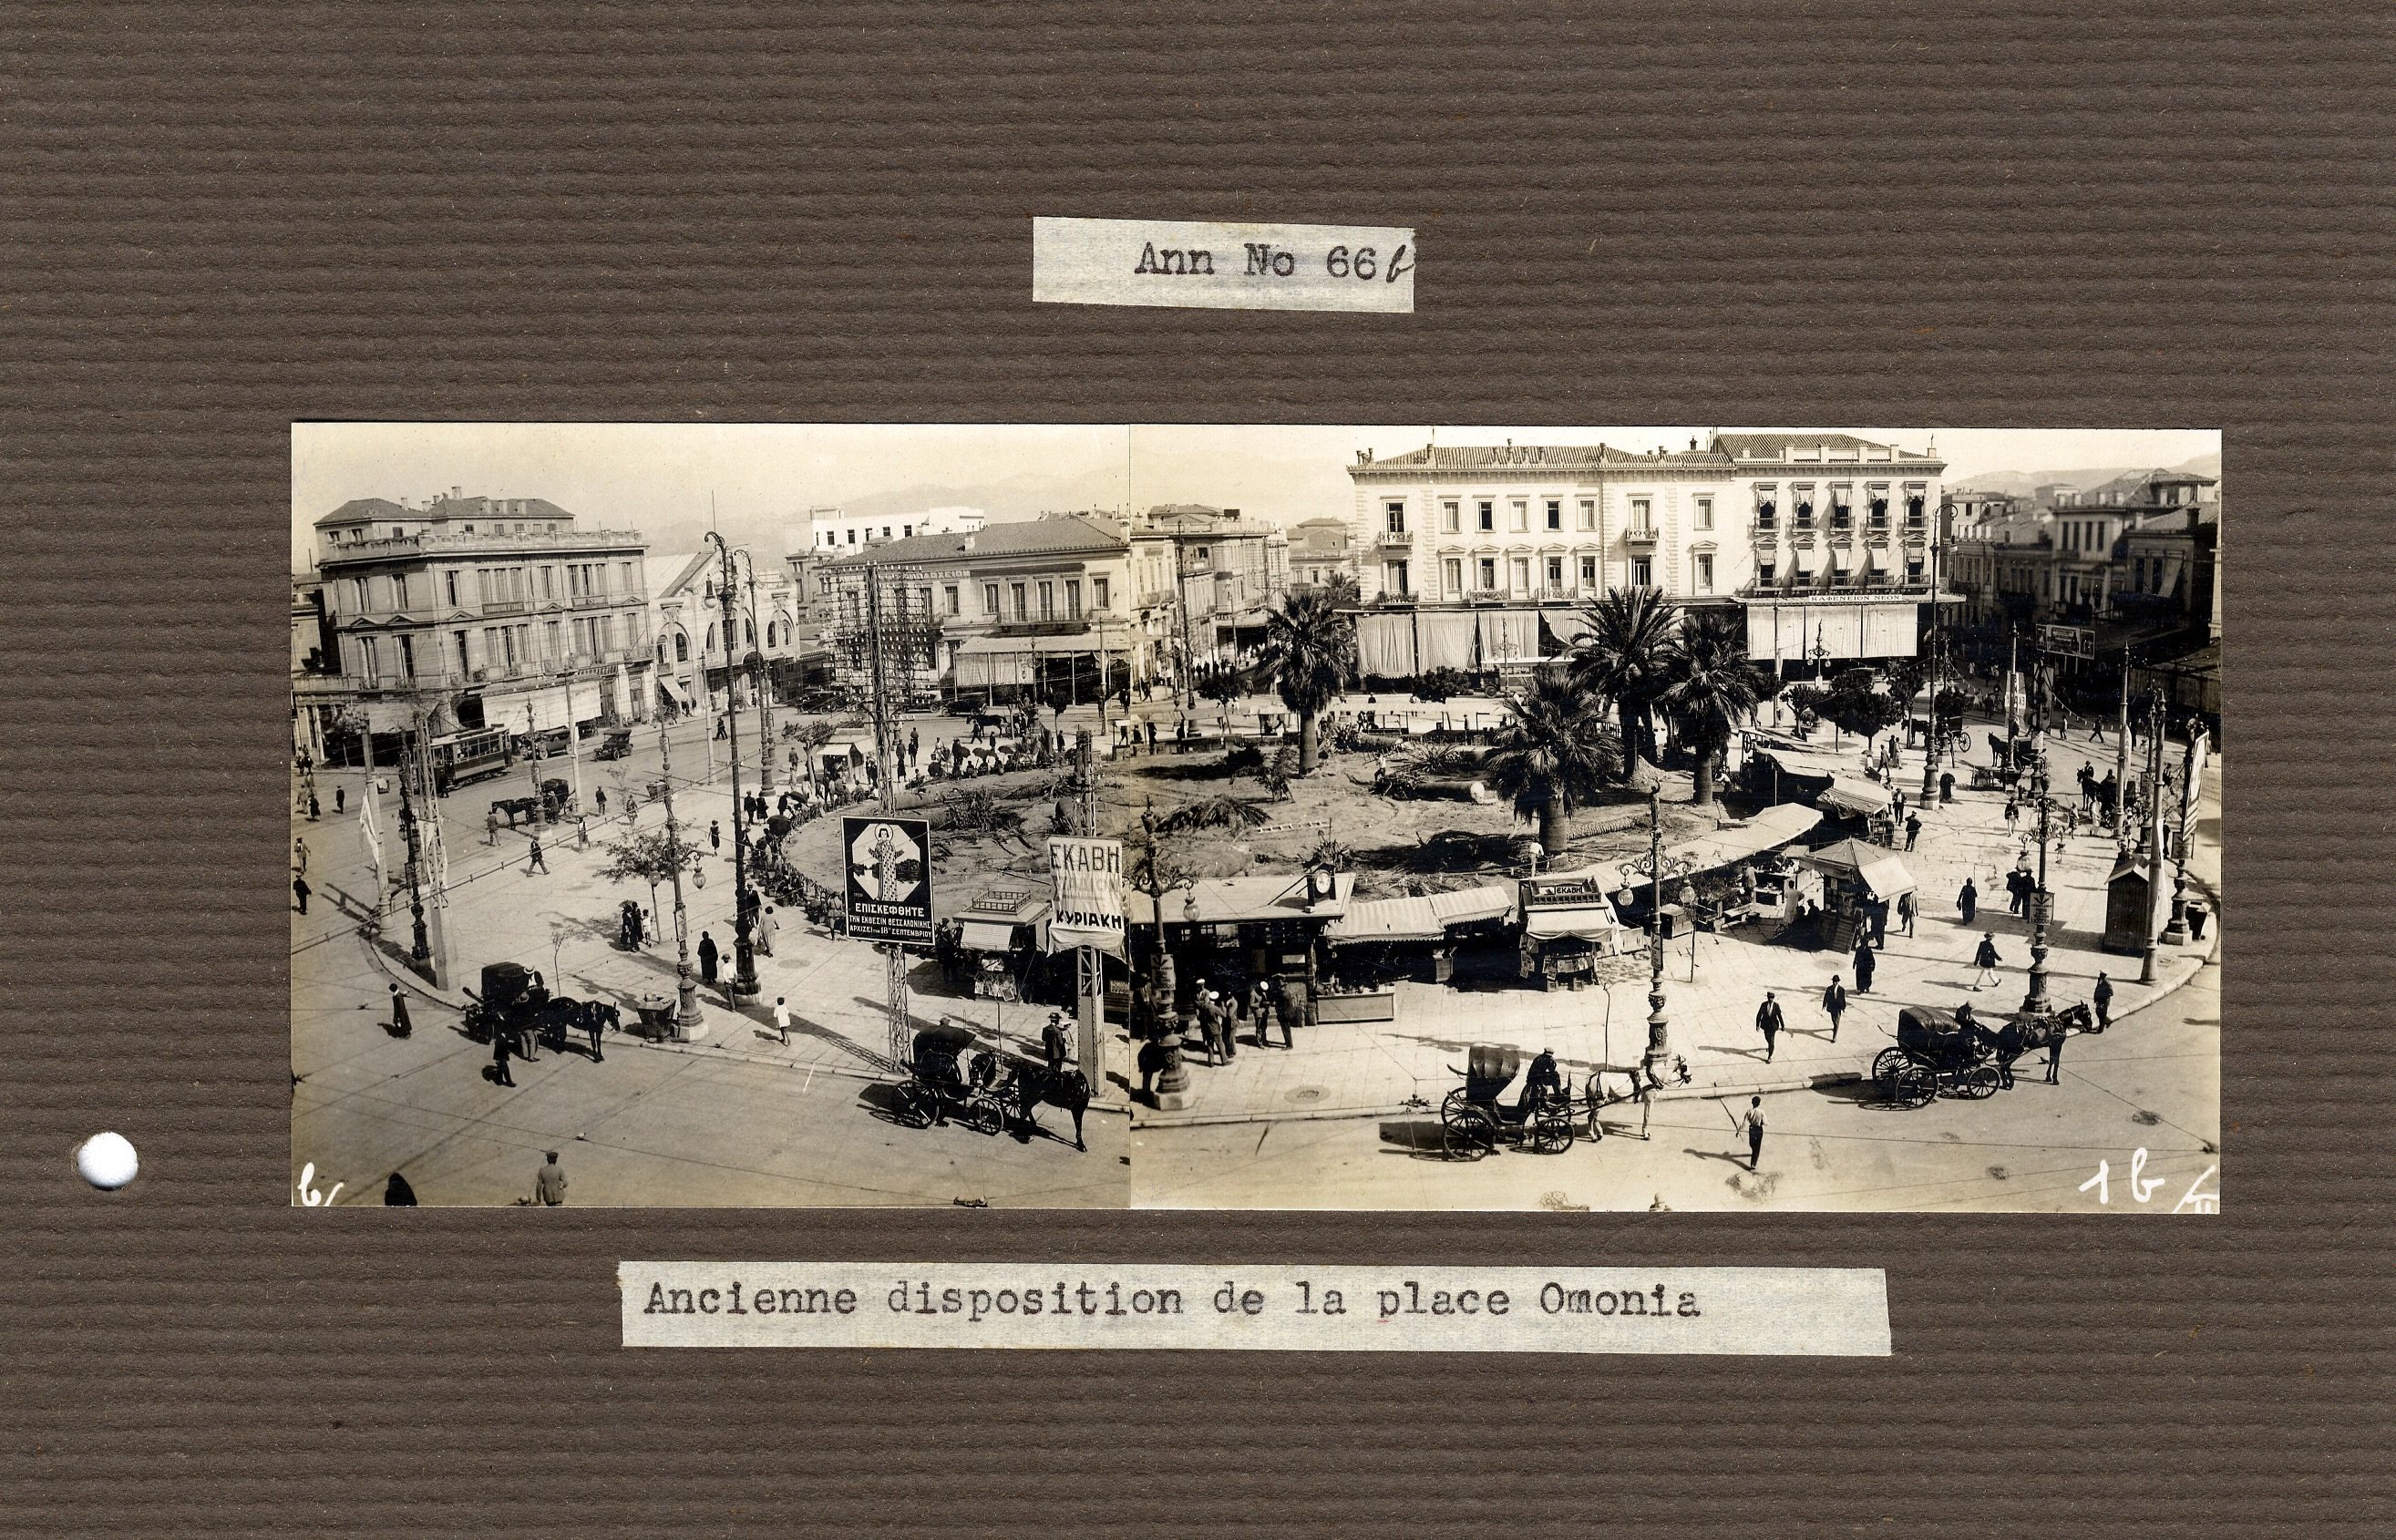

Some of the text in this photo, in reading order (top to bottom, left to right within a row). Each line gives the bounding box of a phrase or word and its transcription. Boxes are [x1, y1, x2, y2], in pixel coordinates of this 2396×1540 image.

[1134, 241, 1215, 275] Ann
[1243, 241, 1296, 276] No
[1049, 844, 1120, 873] ΕΚΑΒΗ
[855, 902, 925, 918] ΕΠΙΣΚΕΦΘΗΤΕ
[1055, 909, 1122, 929] ΚΥΡΙΑΚΗ
[849, 915, 931, 929] ΤΗΝ ΕΚΘΕΣΙΝ ΘΕΣΣΑΛΟΝΙΚΗΣ
[849, 925, 873, 933] ΑΡΧΙΖΕΙ
[891, 929, 931, 938] ΣΕΠΤΕΜΒΡΙΟΥ
[643, 1279, 1702, 1322] Ancienne disposition de la place Omonia
